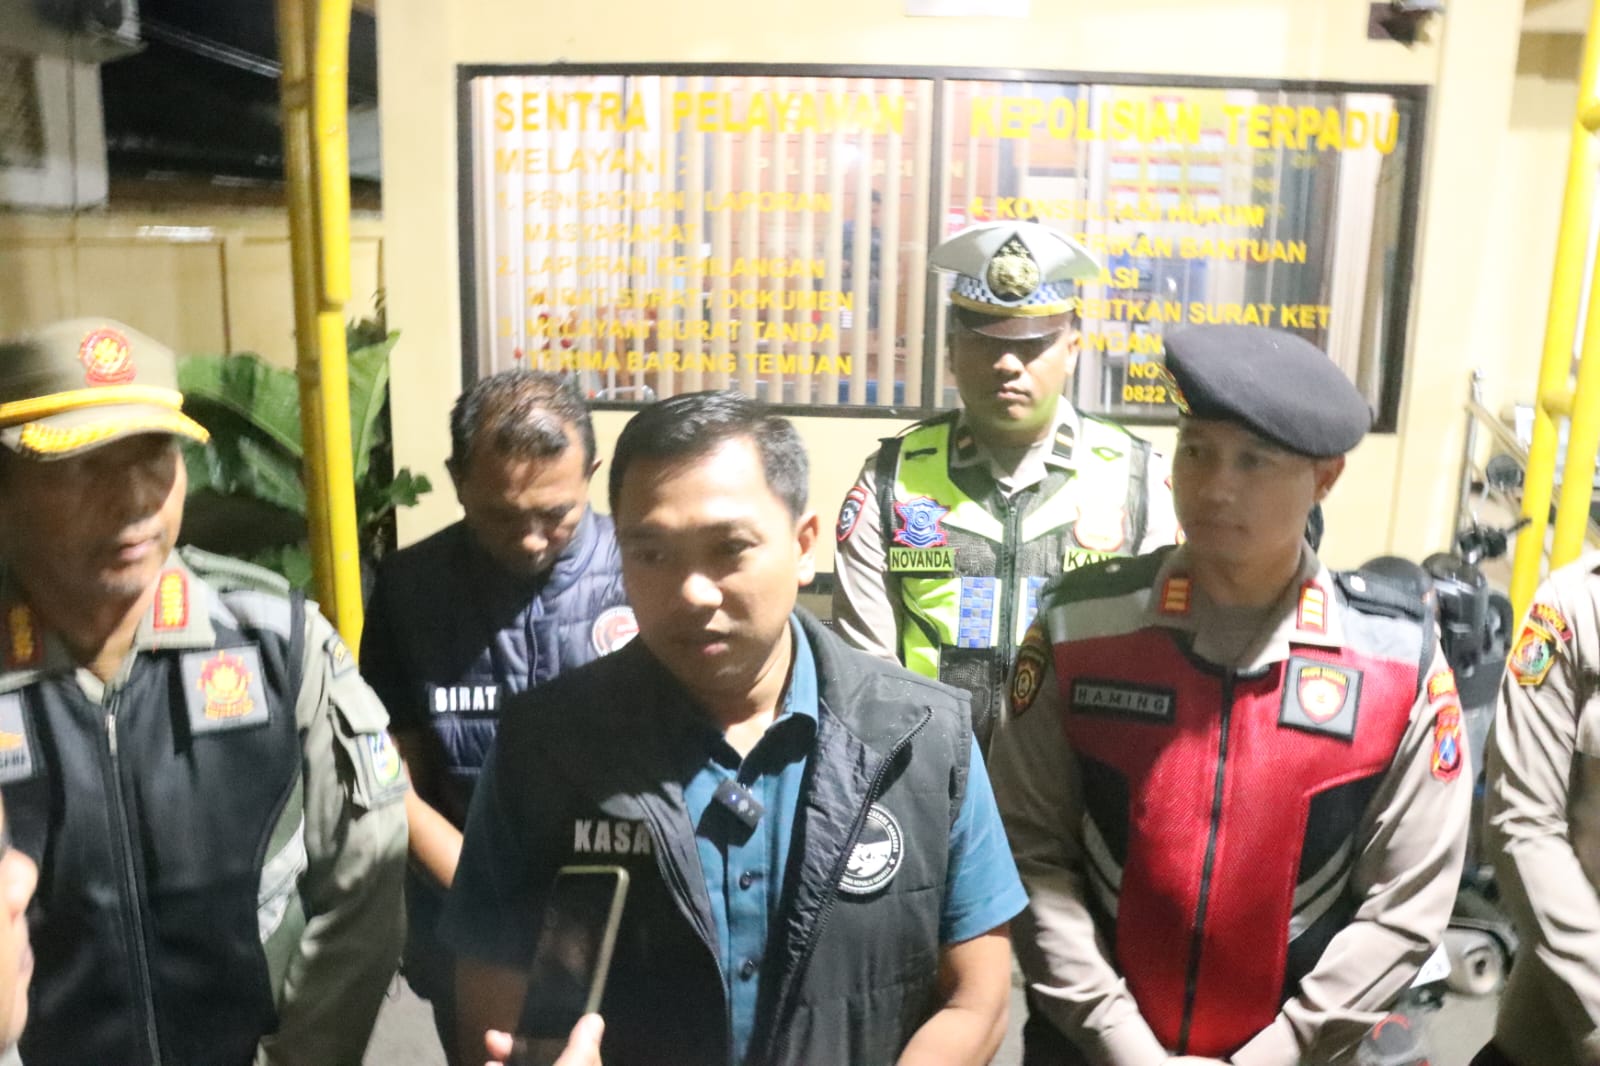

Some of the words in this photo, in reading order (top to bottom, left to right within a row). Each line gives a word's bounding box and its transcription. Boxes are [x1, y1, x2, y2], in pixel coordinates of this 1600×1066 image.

[494, 91, 648, 132] SENTRA
[671, 91, 905, 135] PELAYANAN
[969, 95, 1201, 144] KEPOLISIAN
[1222, 103, 1400, 155] TERPADU
[495, 148, 667, 175] MELAYANI
[523, 190, 686, 212] PENGADUAN
[705, 191, 833, 213] LAPORAN
[995, 197, 1162, 223] KONSULTASI
[1168, 203, 1265, 228] HUKUM
[524, 223, 698, 243] MASYARAKAT
[1179, 236, 1307, 264] BANTUAN
[525, 256, 647, 276] LAPORAN
[656, 257, 826, 279] KEHILANGAN
[720, 289, 854, 312] DOKUMEN
[1188, 302, 1275, 327] SURAT
[1281, 304, 1332, 329] KET
[526, 319, 651, 339] MELAYANI
[657, 319, 740, 342] SURAT
[753, 321, 836, 343] TANDA
[528, 351, 620, 372] TERIMA
[627, 352, 736, 374] BARANG
[744, 353, 852, 375] TEMUAN
[1122, 384, 1166, 404] 0822
[892, 550, 952, 568] NOVANDA
[1077, 687, 1165, 711] HAMING
